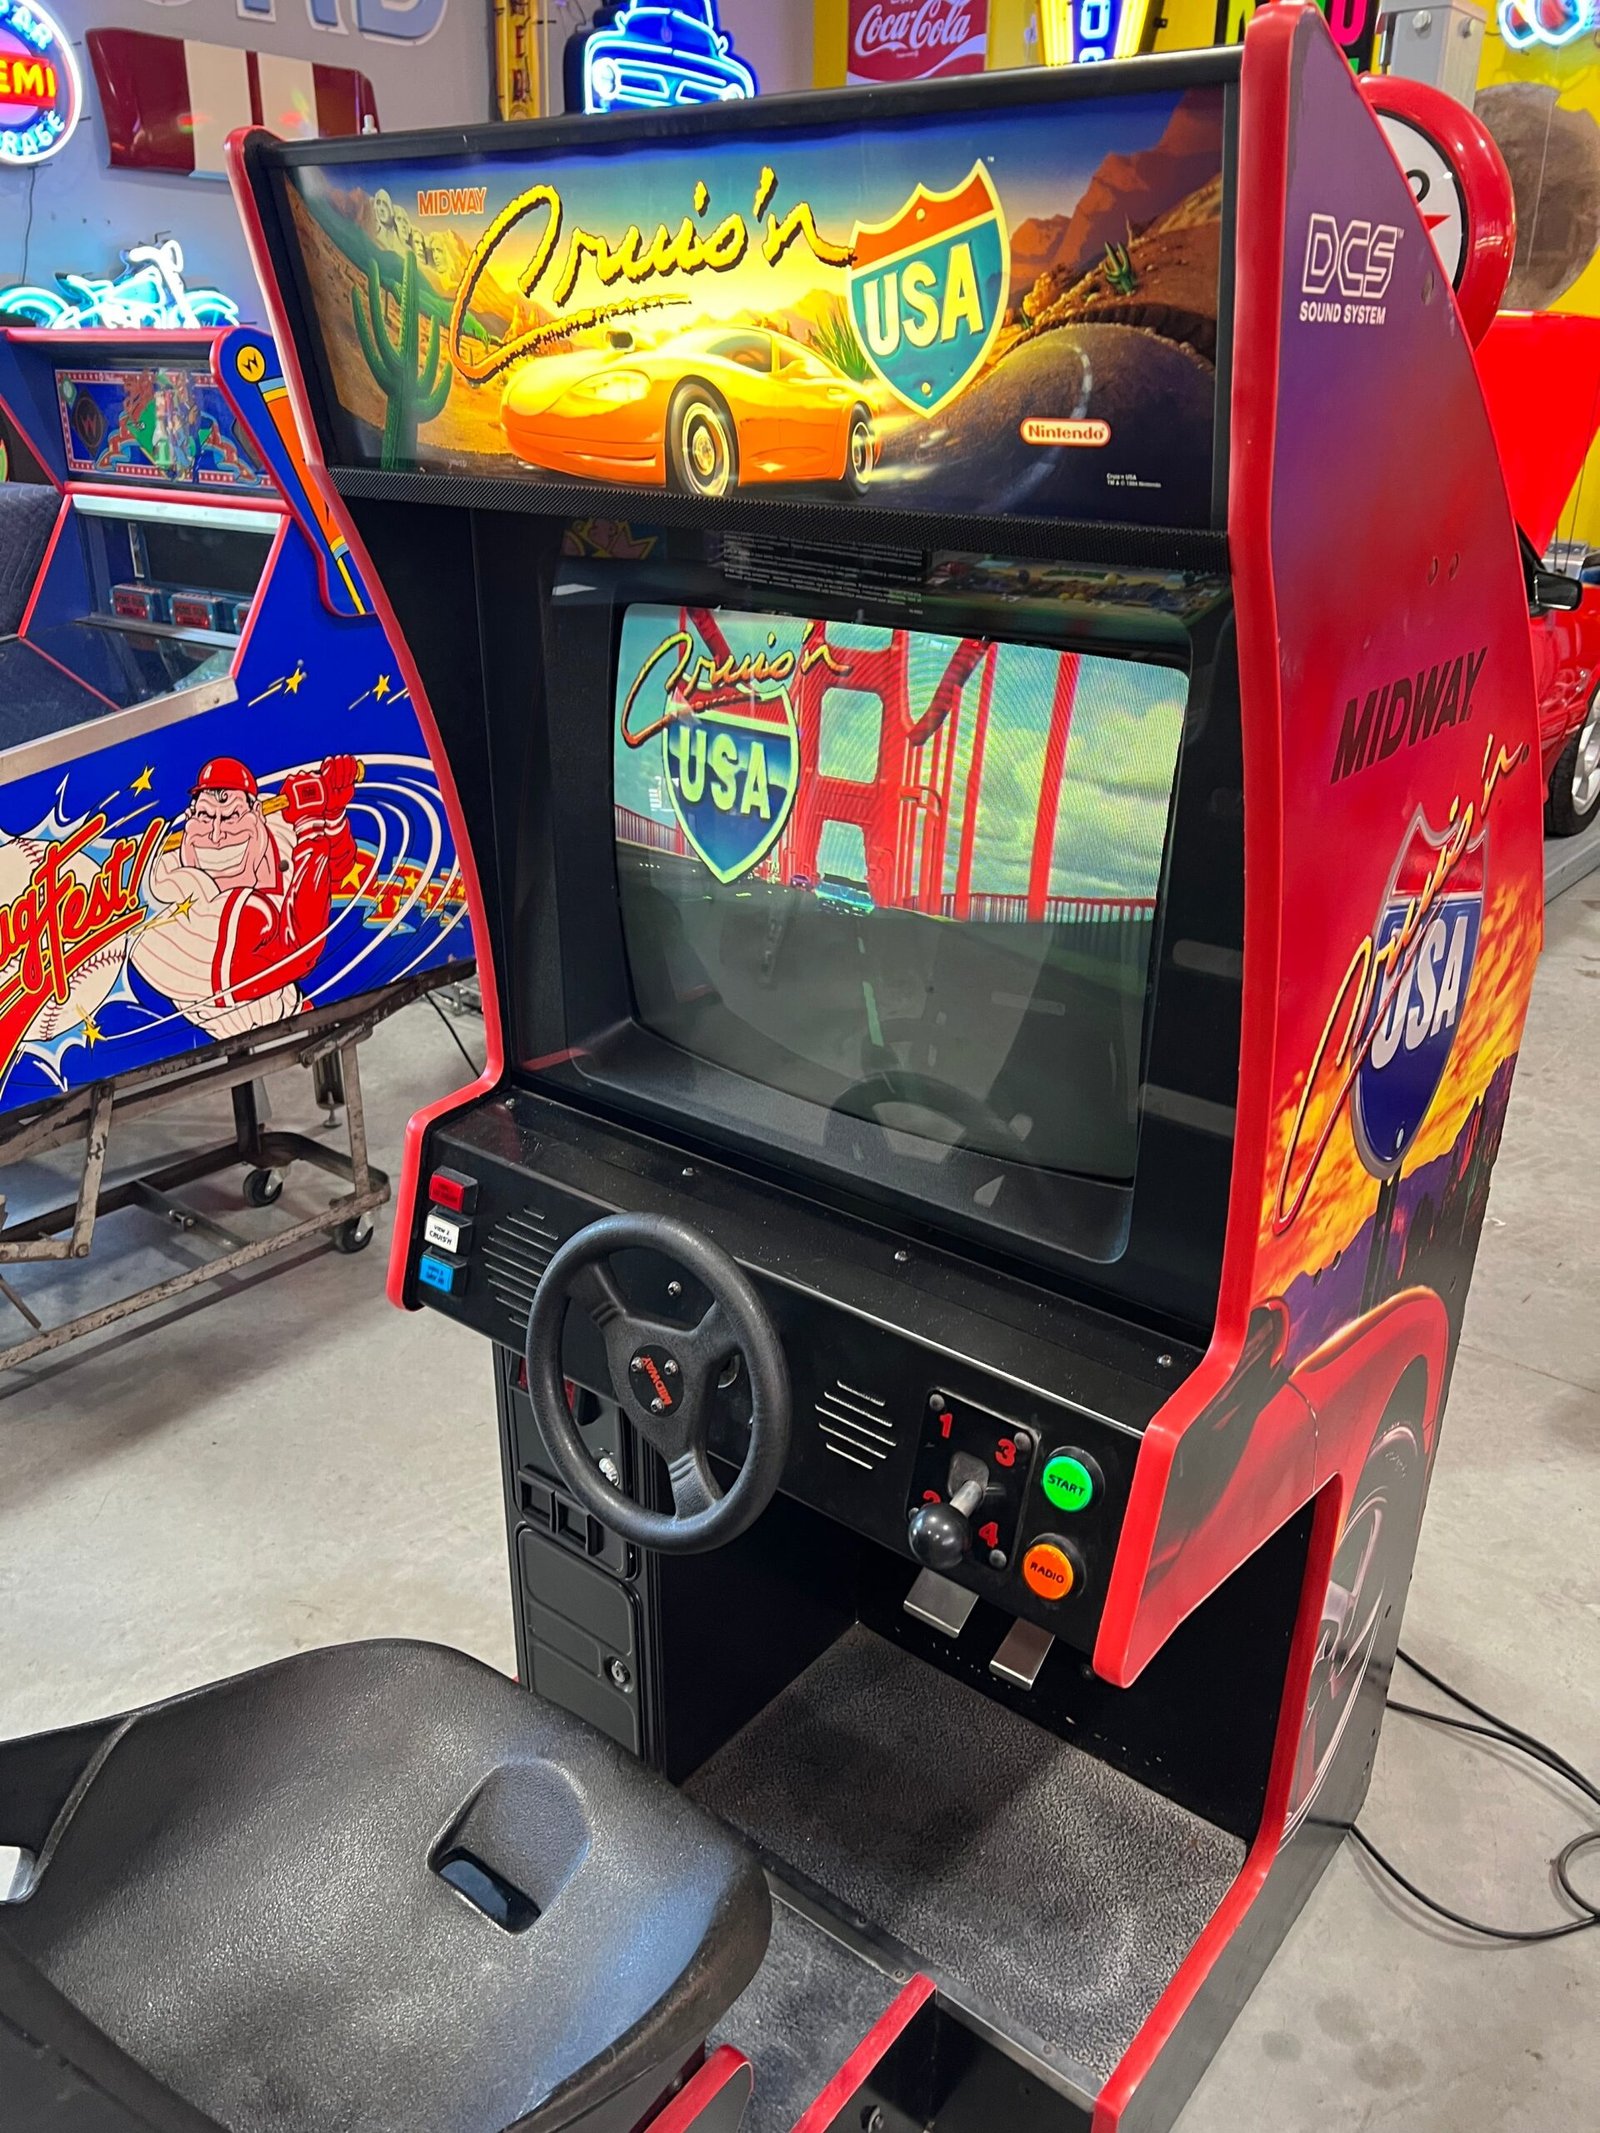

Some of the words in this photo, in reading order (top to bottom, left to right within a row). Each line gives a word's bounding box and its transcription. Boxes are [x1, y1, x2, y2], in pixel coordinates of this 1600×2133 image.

[854, 0, 972, 57] Coca-Cola
[0, 109, 65, 156] RAGE
[417, 186, 488, 217] MIDWAY
[1302, 212, 1399, 300] DCS
[863, 241, 986, 357] USA
[1299, 300, 1342, 323] SOUND
[1343, 304, 1387, 325] SYSTEM
[1027, 423, 1105, 441] Nintendo
[1329, 646, 1488, 785] MIDWAY
[678, 725, 771, 820] USA
[1371, 914, 1471, 1070] USA
[939, 1412, 953, 1439] 1
[995, 1439, 1016, 1467] 3
[1048, 1473, 1085, 1497] START
[978, 1521, 999, 1549] 4
[1029, 1561, 1065, 1584] RADIO
